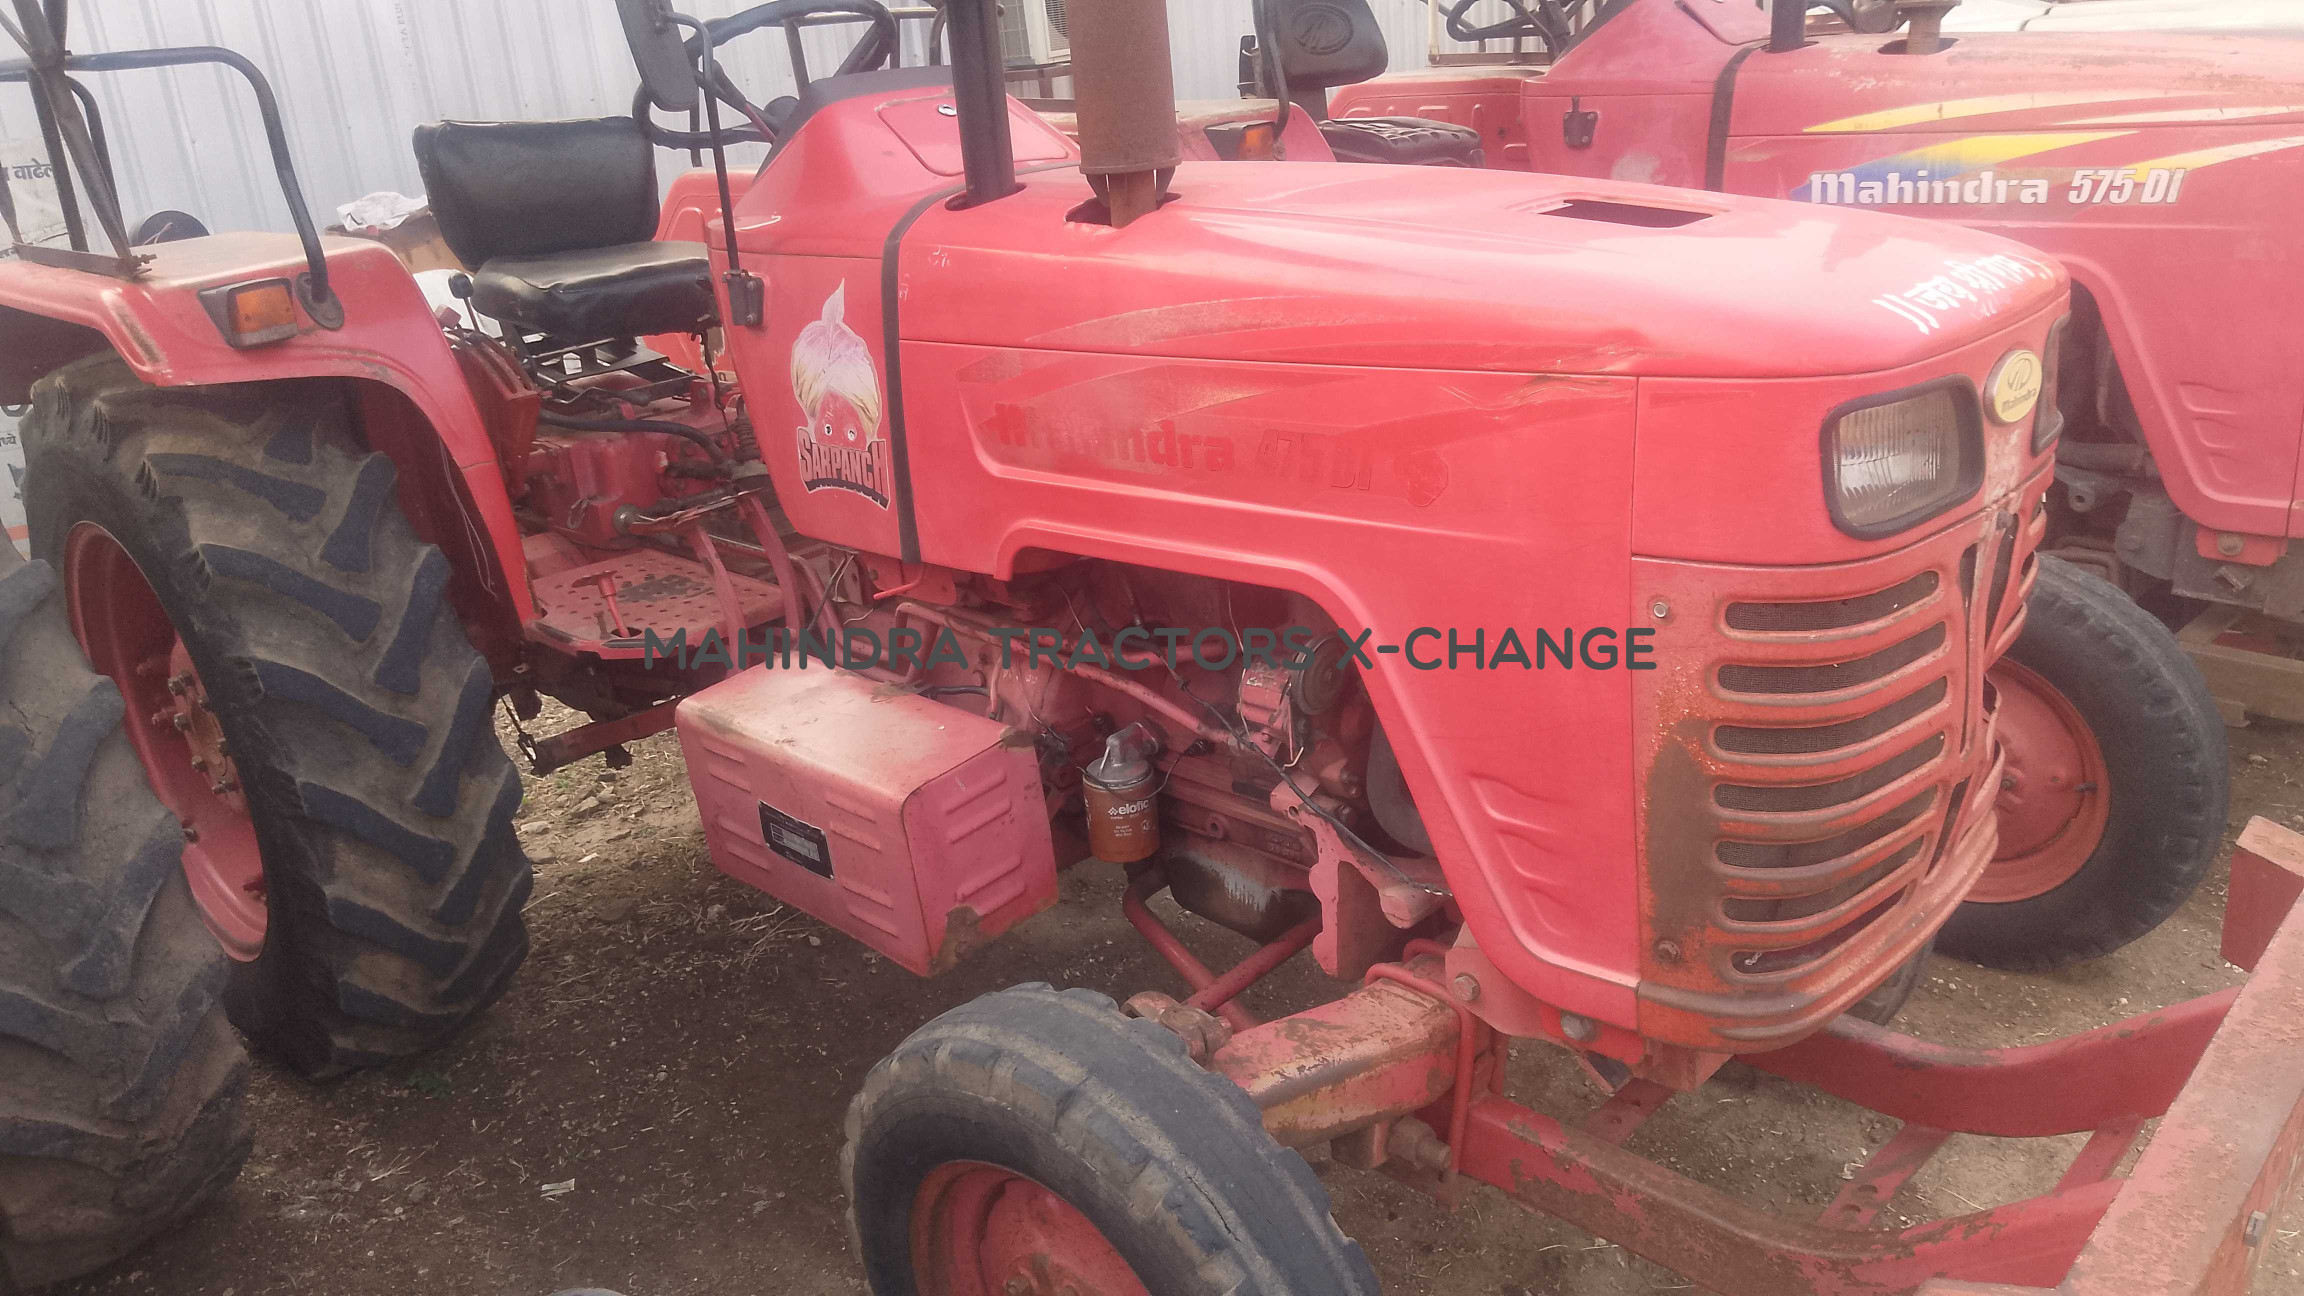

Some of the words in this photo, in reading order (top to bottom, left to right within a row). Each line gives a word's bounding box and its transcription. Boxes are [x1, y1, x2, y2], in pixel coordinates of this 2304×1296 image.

[1810, 170, 2049, 204] Mahindra
[2068, 168, 2137, 204] 575
[2139, 168, 2187, 203] DI
[798, 427, 889, 500] SARPANCH
[995, 402, 1235, 472] Mndra
[1118, 800, 1149, 815] elofic
